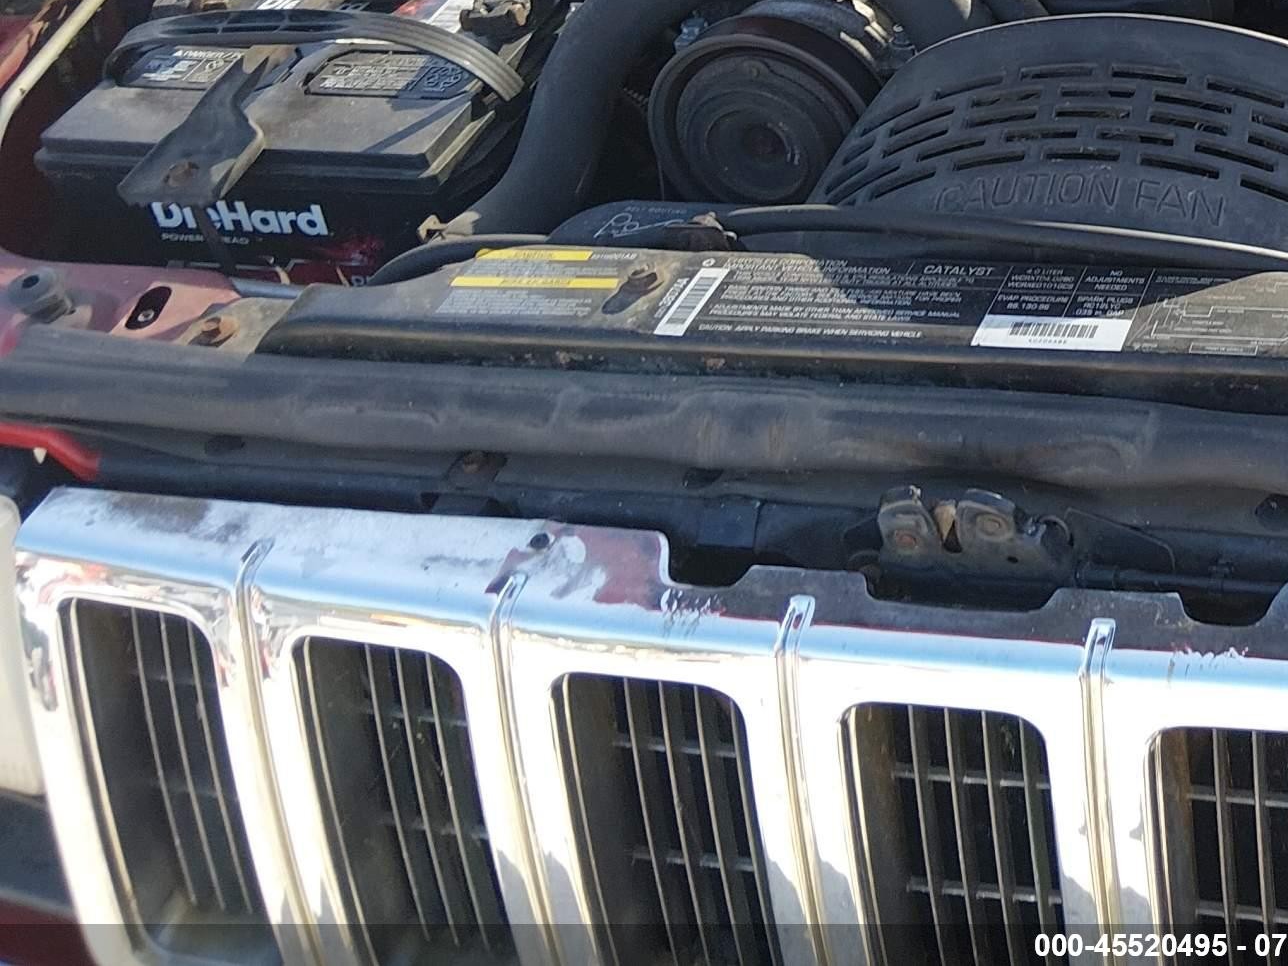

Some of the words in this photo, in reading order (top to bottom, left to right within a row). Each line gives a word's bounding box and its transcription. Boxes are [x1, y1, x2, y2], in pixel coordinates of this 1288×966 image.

[935, 173, 1120, 215] CAUTION
[1134, 179, 1226, 227] FAN
[822, 265, 891, 275] INFORMATION
[923, 264, 994, 277] CATALYST
[1085, 277, 1146, 285] ADJUSTMENTS
[1094, 283, 1128, 291] NEEDED
[998, 294, 1020, 302] EVAP
[1020, 295, 1069, 304] PROCEDURE
[1076, 296, 1104, 304] SPARK
[1106, 297, 1134, 305] PLUGS
[761, 325, 795, 334] PARKING
[822, 328, 848, 336] WHEN
[849, 328, 890, 338] SERVICING
[890, 331, 923, 339] VEHICLE
